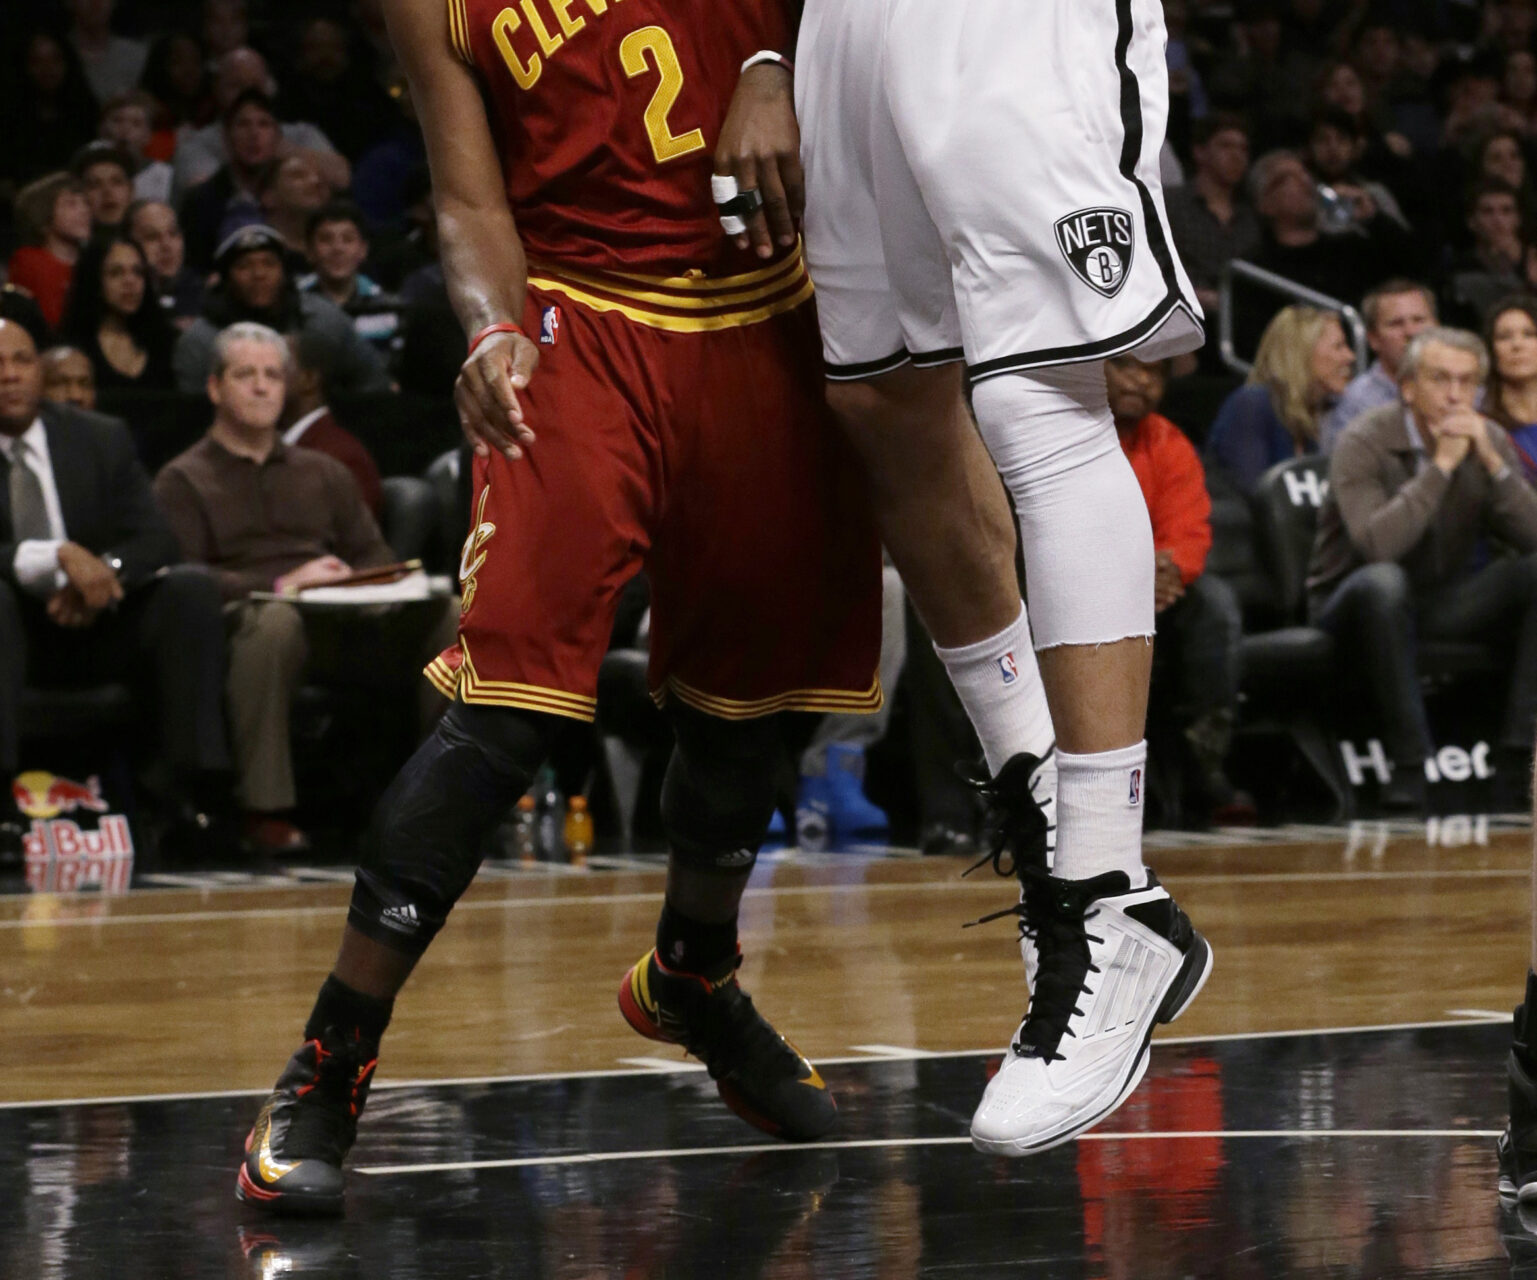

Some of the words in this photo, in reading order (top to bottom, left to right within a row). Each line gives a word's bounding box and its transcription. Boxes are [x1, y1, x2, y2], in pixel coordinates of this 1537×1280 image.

[619, 25, 706, 164] 2
[1062, 212, 1131, 254] NETS
[1098, 252, 1113, 284] B
[1340, 739, 1492, 784] Her
[52, 817, 133, 858] Bull
